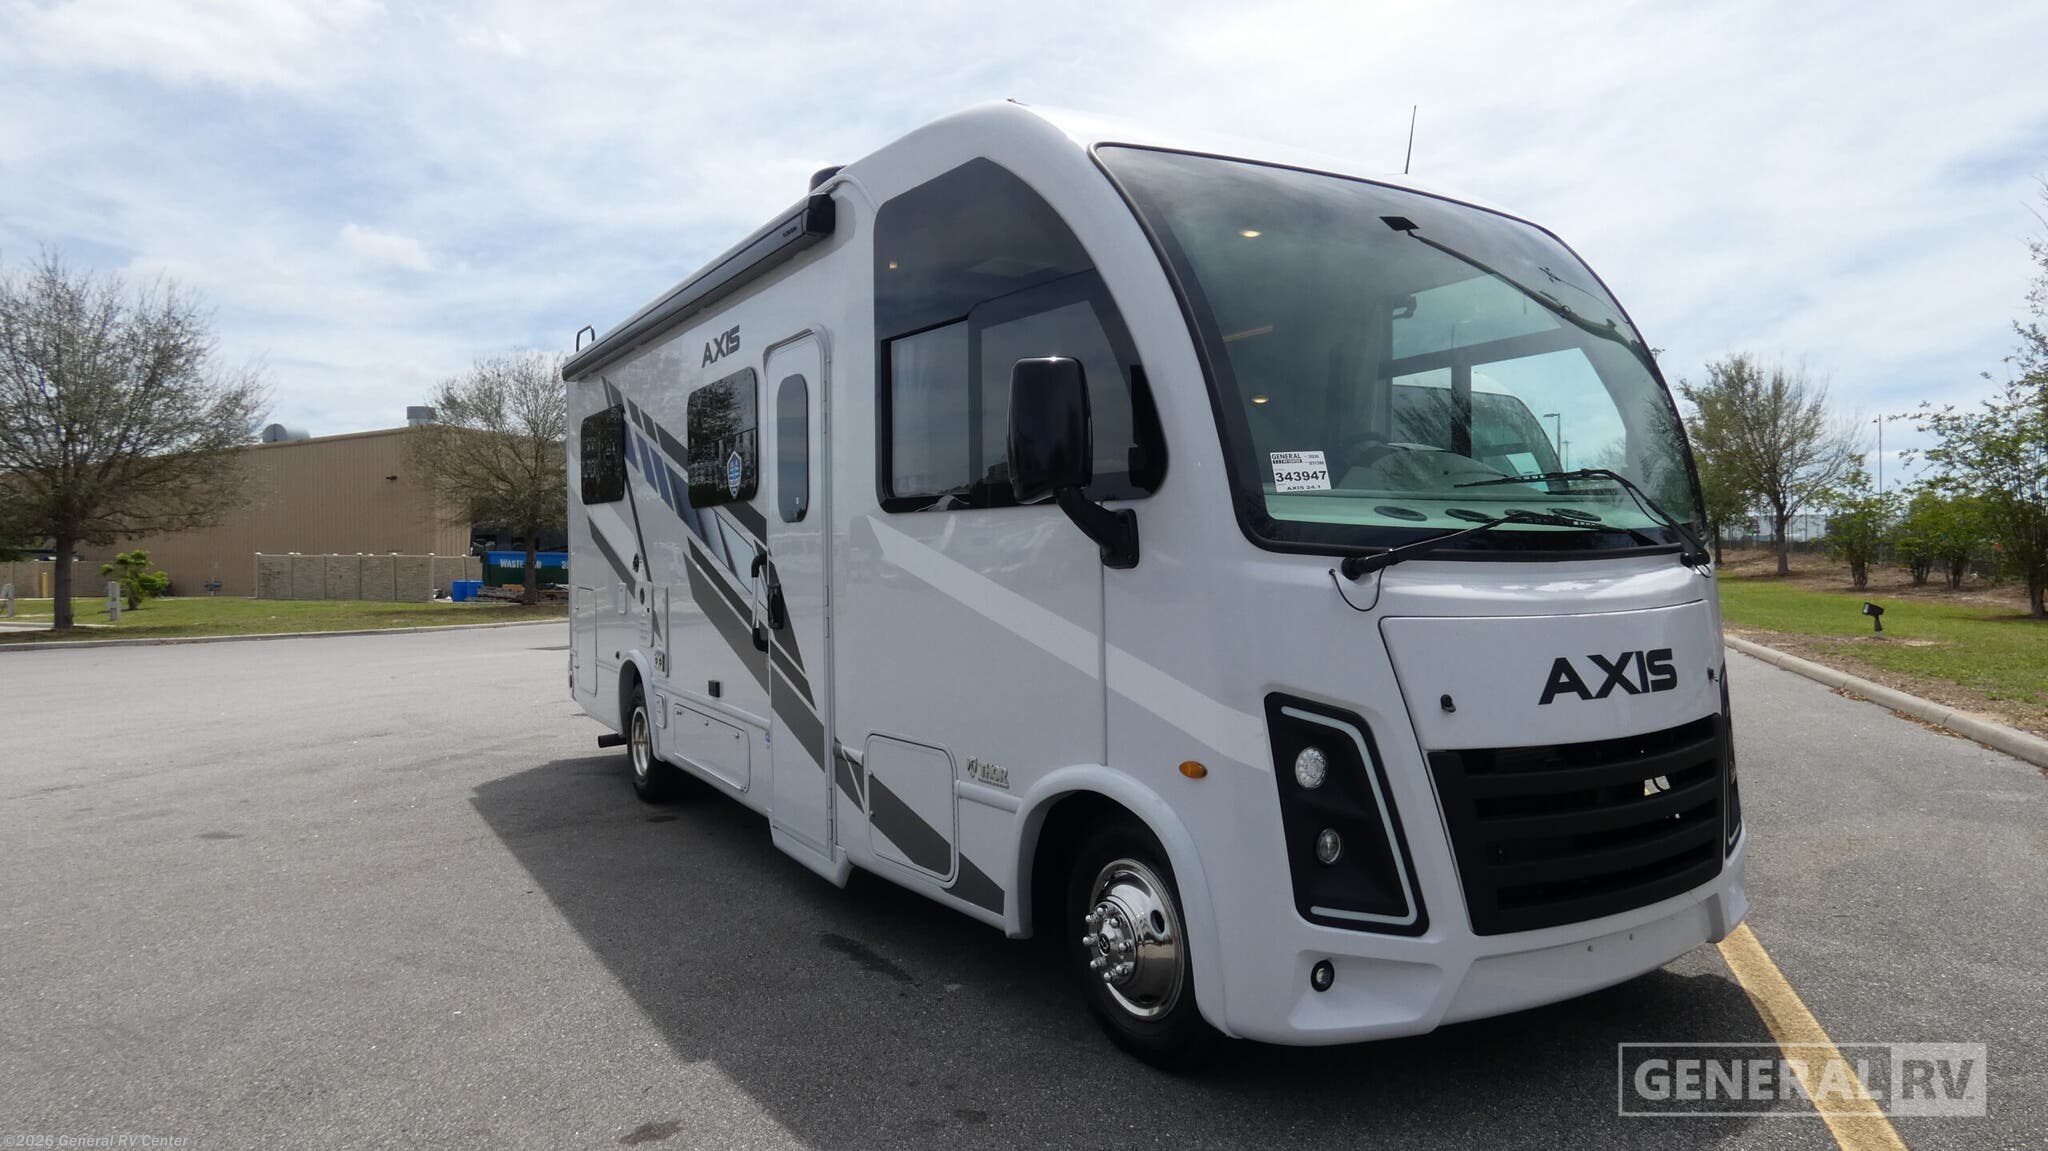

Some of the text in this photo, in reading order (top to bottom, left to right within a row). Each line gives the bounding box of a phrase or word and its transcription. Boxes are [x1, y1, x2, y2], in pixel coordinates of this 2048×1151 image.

[702, 324, 740, 368] AXIS
[1275, 471, 1326, 482] 343947
[500, 559, 525, 569] WASTE
[1538, 648, 1678, 705] AXIS
